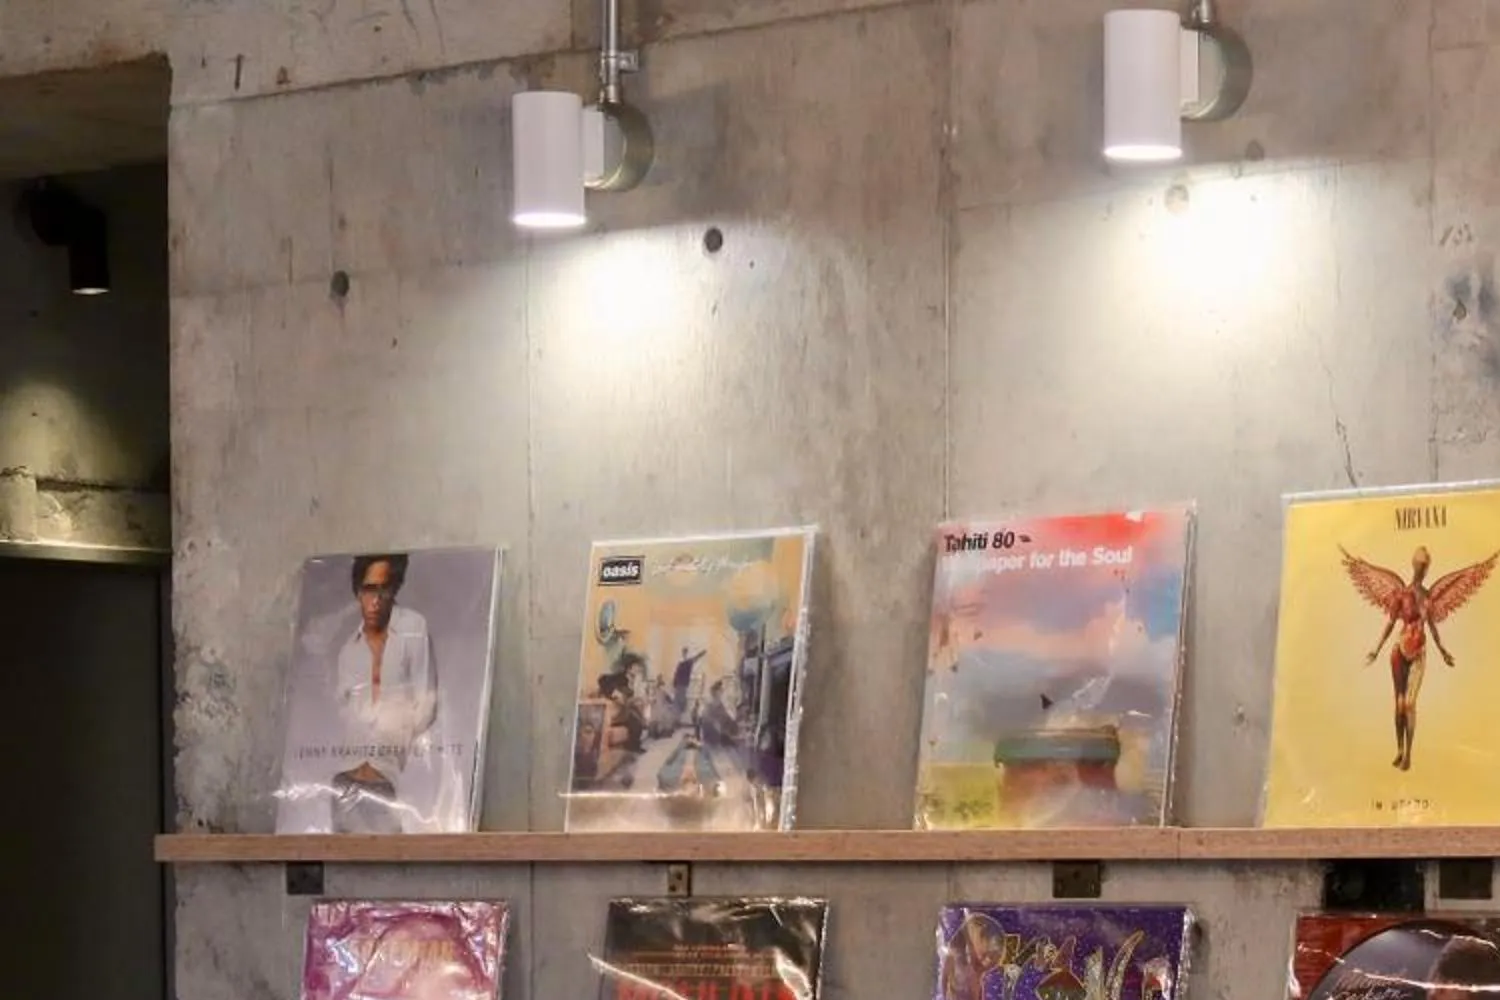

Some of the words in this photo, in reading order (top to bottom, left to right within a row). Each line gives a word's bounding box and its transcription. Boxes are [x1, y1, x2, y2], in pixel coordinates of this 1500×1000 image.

[943, 534, 989, 553] Tahiti
[992, 531, 1015, 550] 80
[1029, 550, 1053, 569] for
[1058, 548, 1087, 566] the
[1092, 544, 1134, 564] Soul
[602, 563, 639, 578] oasis
